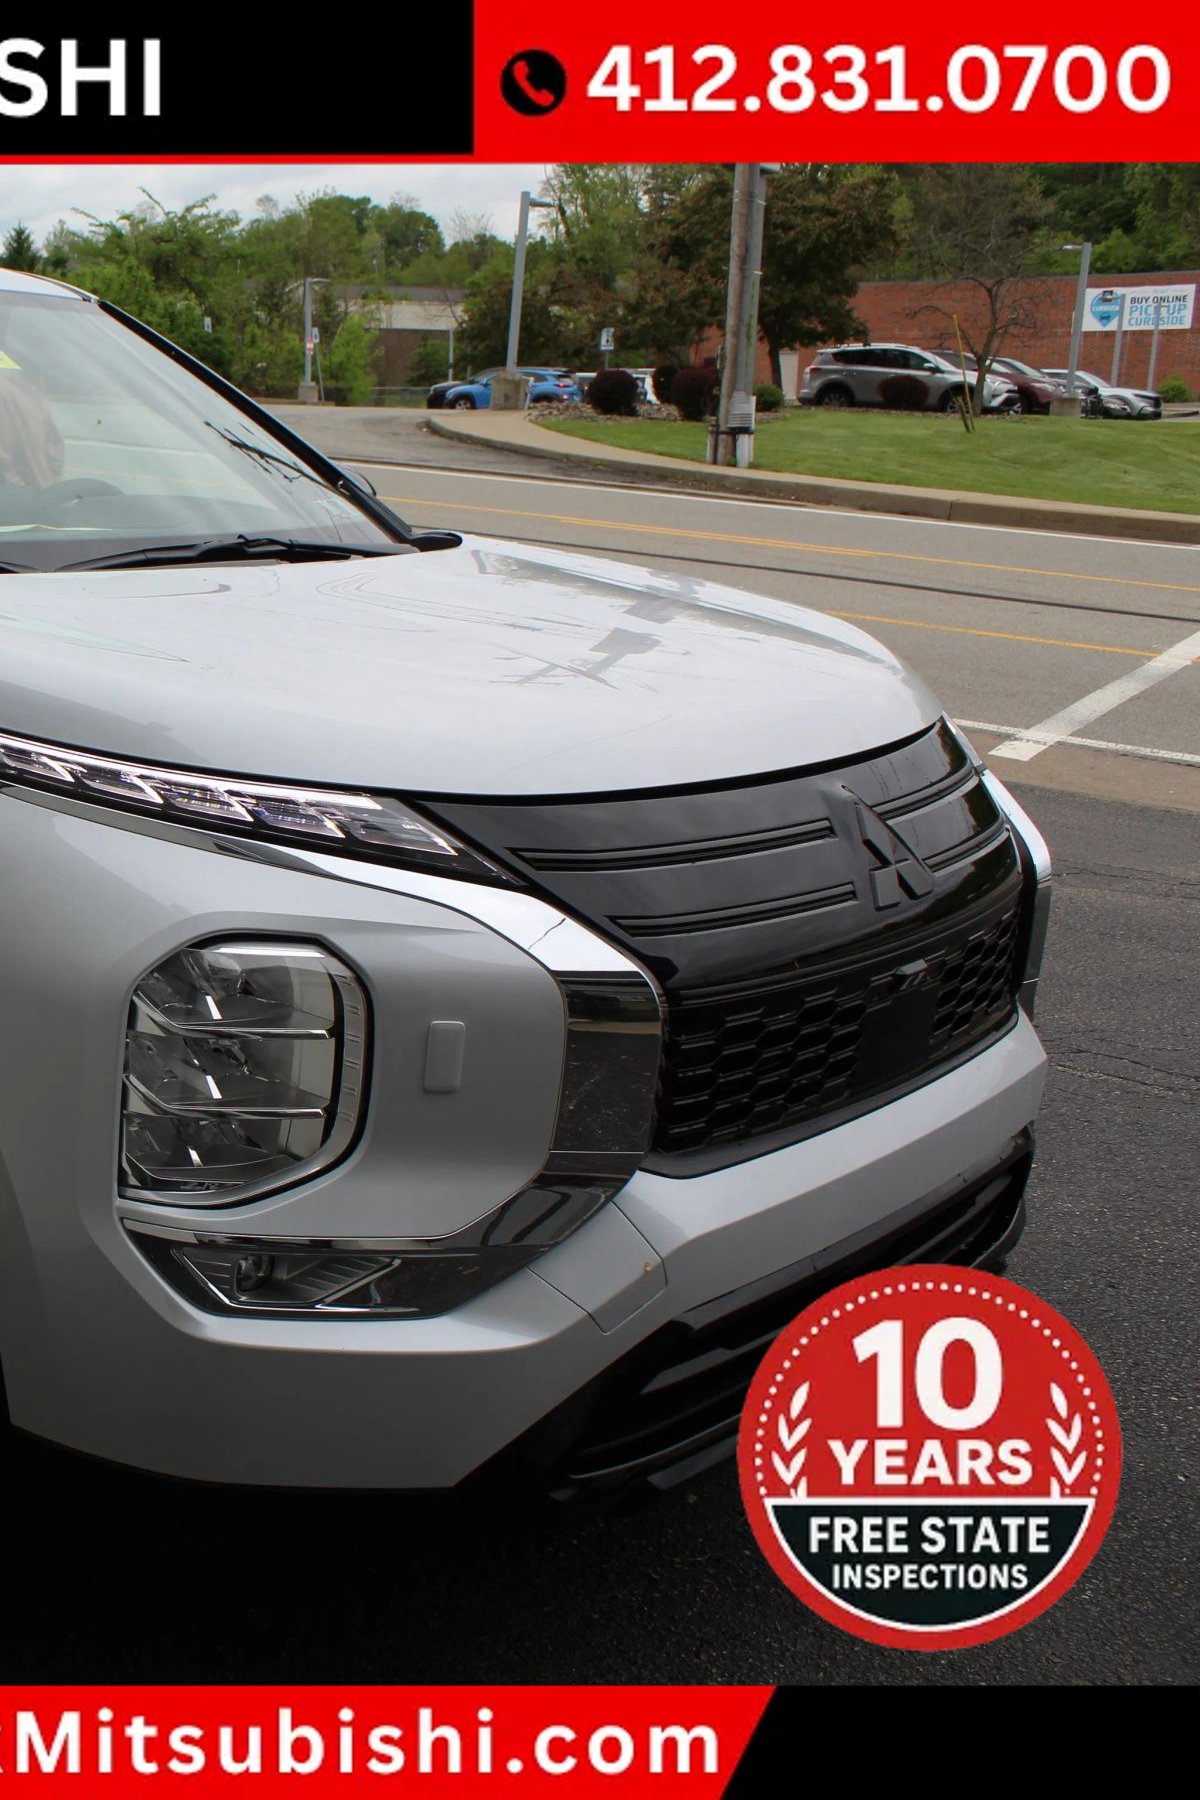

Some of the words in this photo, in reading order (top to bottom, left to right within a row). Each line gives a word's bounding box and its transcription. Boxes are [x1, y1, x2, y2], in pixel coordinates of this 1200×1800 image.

[1130, 297, 1150, 305] BUY
[1152, 295, 1189, 304] ONLINE
[1129, 304, 1161, 316] PIC
